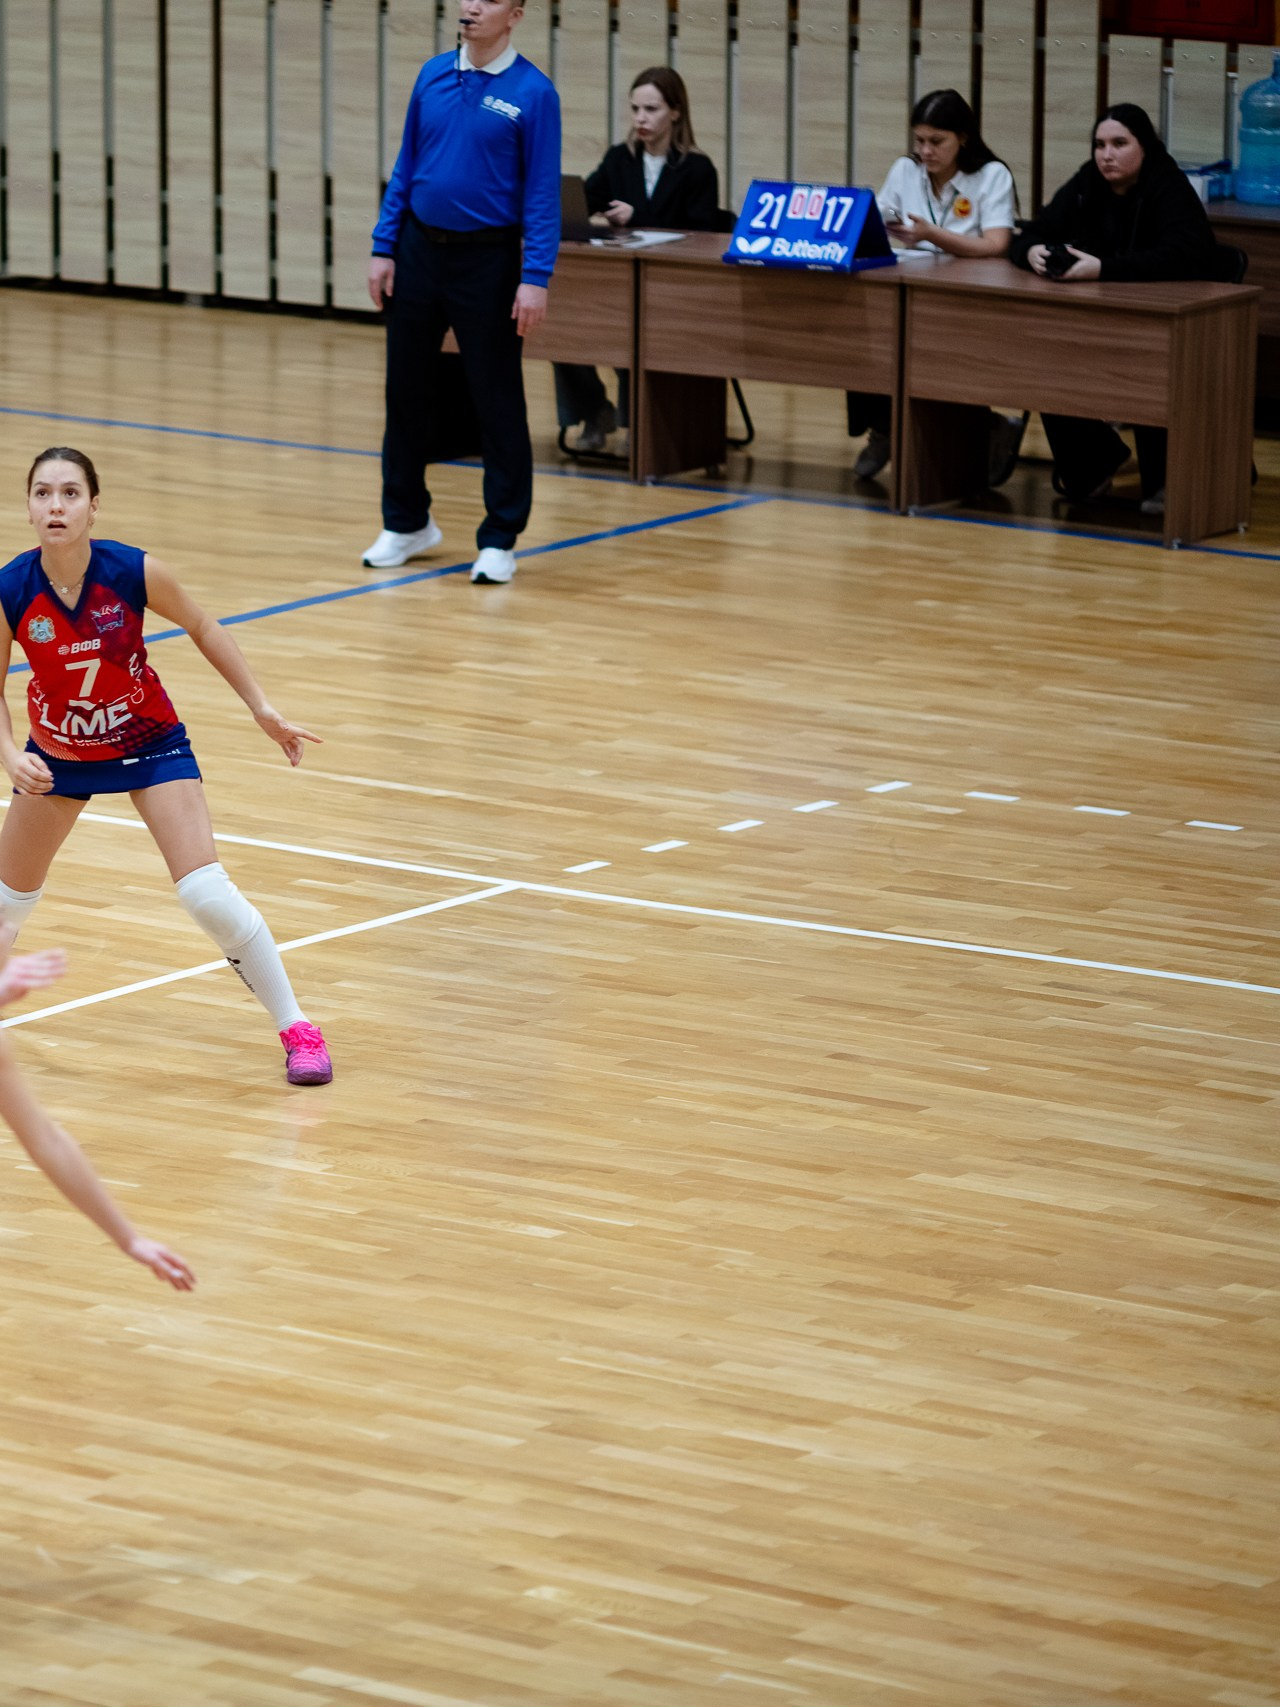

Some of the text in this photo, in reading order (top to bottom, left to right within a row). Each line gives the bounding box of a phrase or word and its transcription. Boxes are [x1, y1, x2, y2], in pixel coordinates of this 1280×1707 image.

[750, 192, 786, 230] 21
[822, 196, 854, 233] 17
[771, 237, 849, 263] Butterfly
[71, 639, 101, 654] ВФВ
[65, 658, 101, 697] 7
[39, 701, 133, 735] LIME
